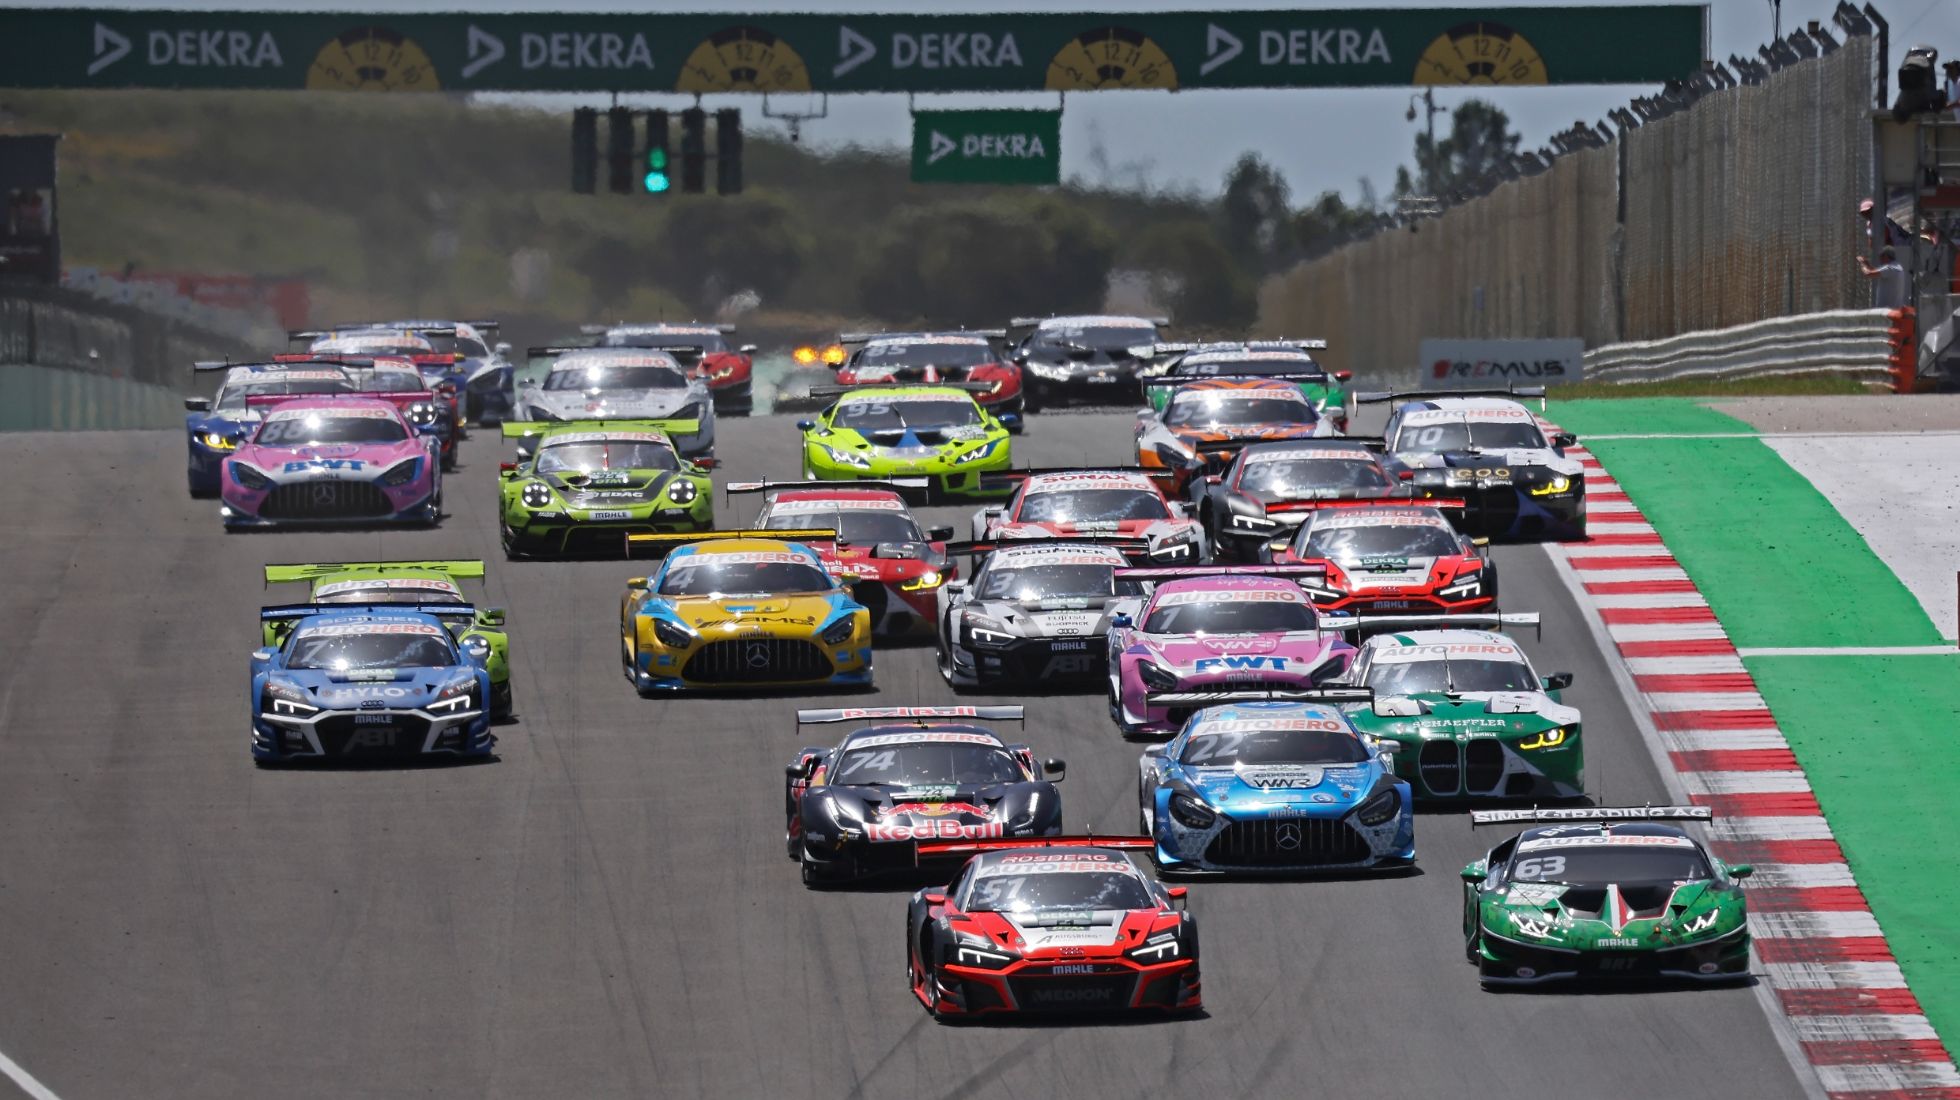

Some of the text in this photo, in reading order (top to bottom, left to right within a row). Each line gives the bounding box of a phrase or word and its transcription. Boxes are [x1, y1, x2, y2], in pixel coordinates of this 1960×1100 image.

[149, 31, 282, 66] DEKRA
[522, 33, 654, 69] DEKRA
[892, 33, 1022, 69] DEKRA
[1260, 29, 1391, 65] DEKRA
[962, 134, 1045, 158] DEKRA
[1453, 358, 1566, 378] REMUS
[847, 403, 890, 417] 95
[1411, 408, 1526, 421] AUTOHERO
[1402, 426, 1445, 447] 10
[284, 459, 367, 474] BWT
[1035, 482, 1150, 492] AUTOHERO
[1042, 475, 1129, 485] SONAX
[779, 501, 899, 511] AUTOHERO
[1320, 517, 1441, 528] AUTOHERO
[1320, 530, 1357, 551] 12
[686, 552, 807, 564] AUTOHERO
[1000, 556, 1122, 568] AUTOHERO
[667, 567, 696, 589] 4
[987, 573, 1016, 595] 3
[324, 580, 451, 594] AUTOHERO
[1167, 591, 1296, 604] AUTOHERO
[1159, 607, 1181, 630] 1
[308, 625, 438, 637] AUTOHERO
[303, 638, 328, 663] 7
[1051, 642, 1087, 651] MAHLE
[1380, 645, 1514, 658] AUTOHERO
[1195, 656, 1288, 673] BWT
[1372, 662, 1412, 684] 11
[335, 687, 405, 699] HYLO
[355, 715, 393, 724] MAHLE
[1205, 719, 1341, 733] AUTOHERO
[1412, 719, 1507, 729] SCHAEFFLER
[860, 732, 993, 746] AUTOHERO
[1190, 733, 1244, 760] 22
[841, 750, 895, 776] 74
[1267, 807, 1307, 818] MAHLE
[1672, 807, 1709, 817] AG
[866, 819, 1003, 843] Red Bull
[1540, 836, 1679, 847] AUTOHERO
[1001, 854, 1109, 865] ROSBERG
[982, 862, 1130, 877] AUTOHERO
[1514, 855, 1566, 879] 63
[978, 877, 1027, 904] 51
[1597, 938, 1638, 947] MAHLE
[1053, 965, 1094, 975] MAHLE
[1032, 987, 1111, 1002] MEDION
